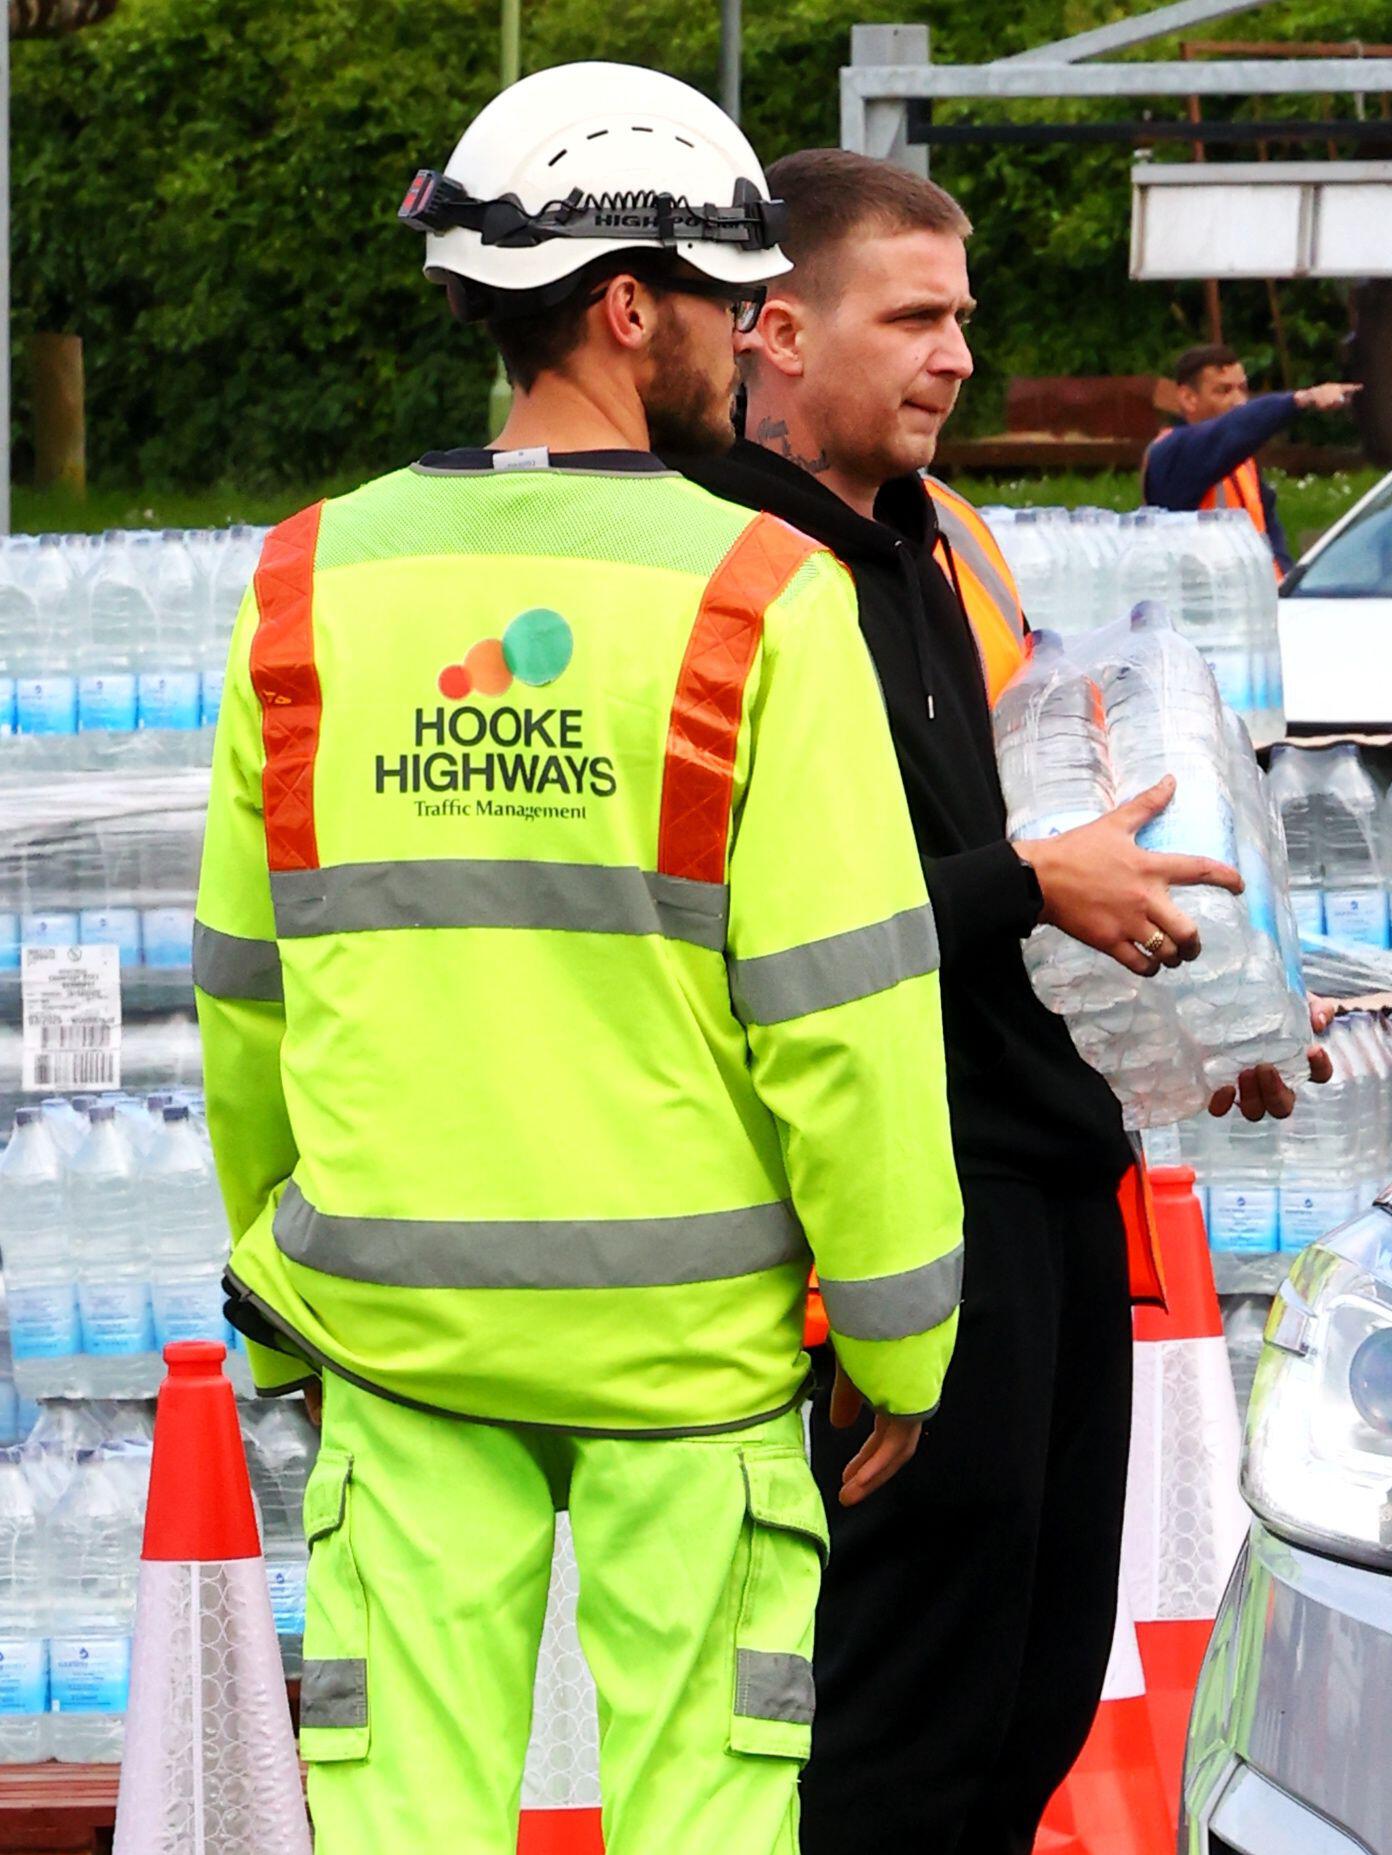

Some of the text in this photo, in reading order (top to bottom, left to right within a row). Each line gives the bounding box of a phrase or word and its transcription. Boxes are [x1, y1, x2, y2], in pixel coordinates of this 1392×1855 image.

[414, 706, 583, 748] HOOKE
[375, 752, 617, 797] HIGHWAYS
[414, 799, 587, 821] Traffic Management
